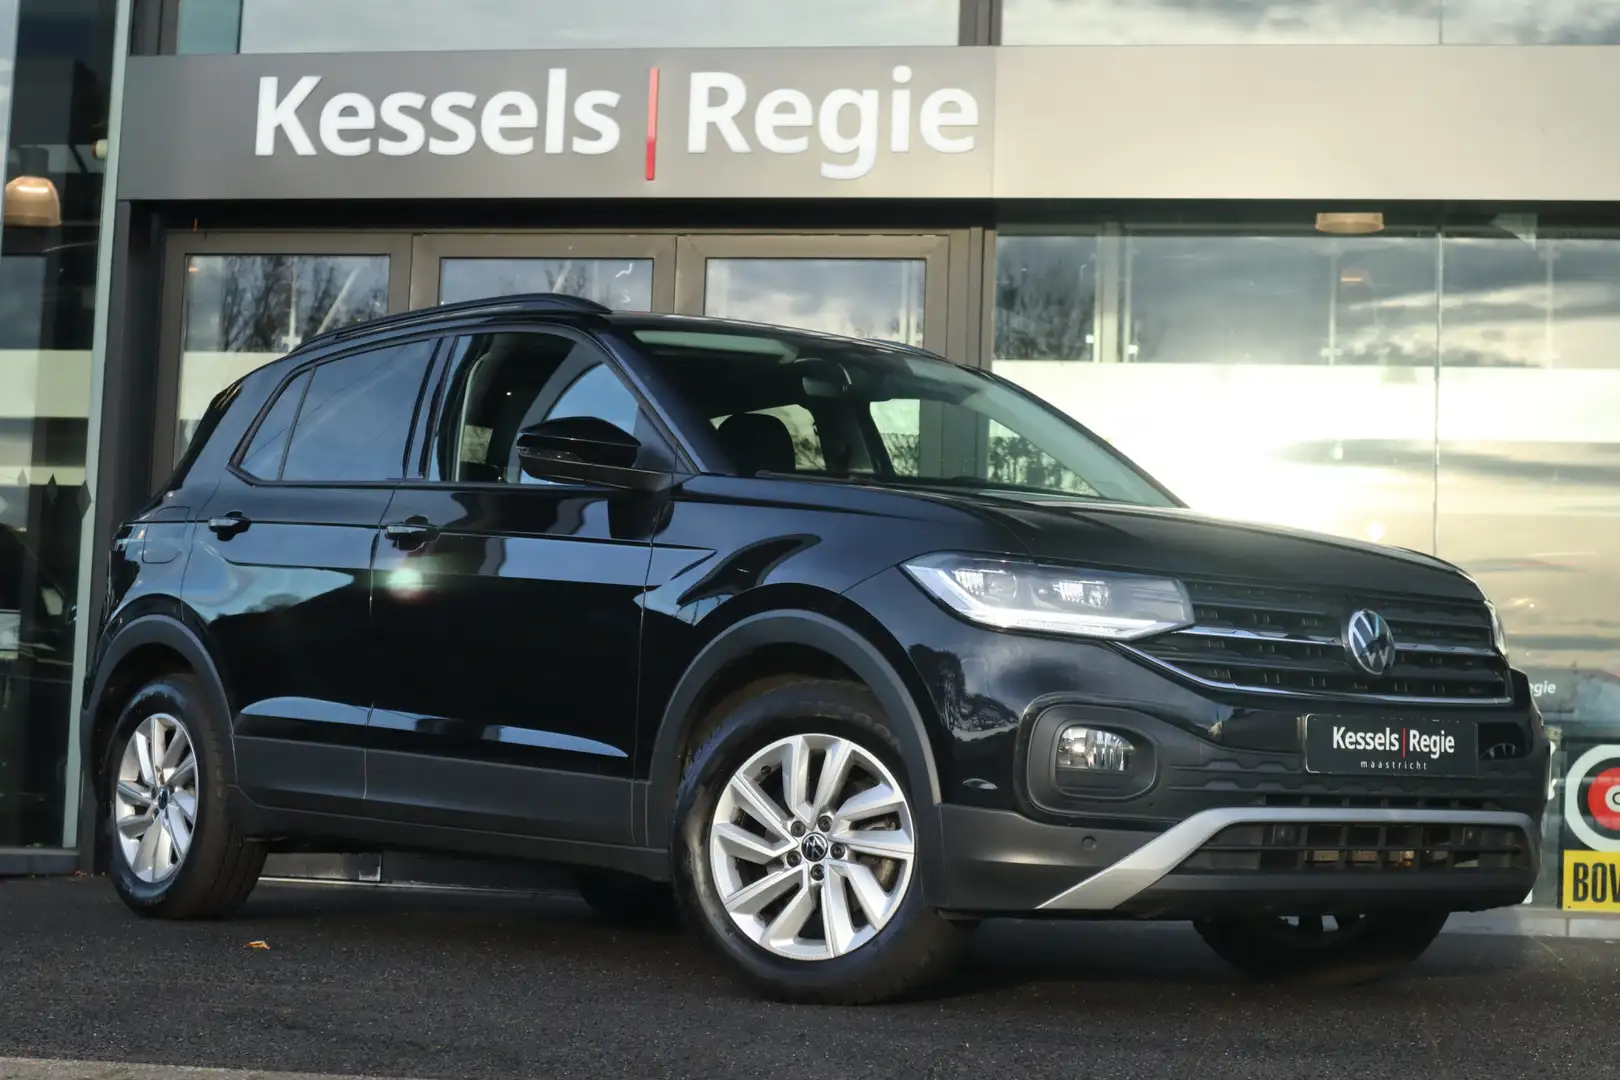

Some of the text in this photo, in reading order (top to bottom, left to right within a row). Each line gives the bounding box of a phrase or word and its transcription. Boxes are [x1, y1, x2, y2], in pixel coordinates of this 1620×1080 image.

[255, 66, 980, 180] Kessels Regie
[1332, 726, 1455, 760] Kessels Regie
[1360, 760, 1428, 770] maastricht
